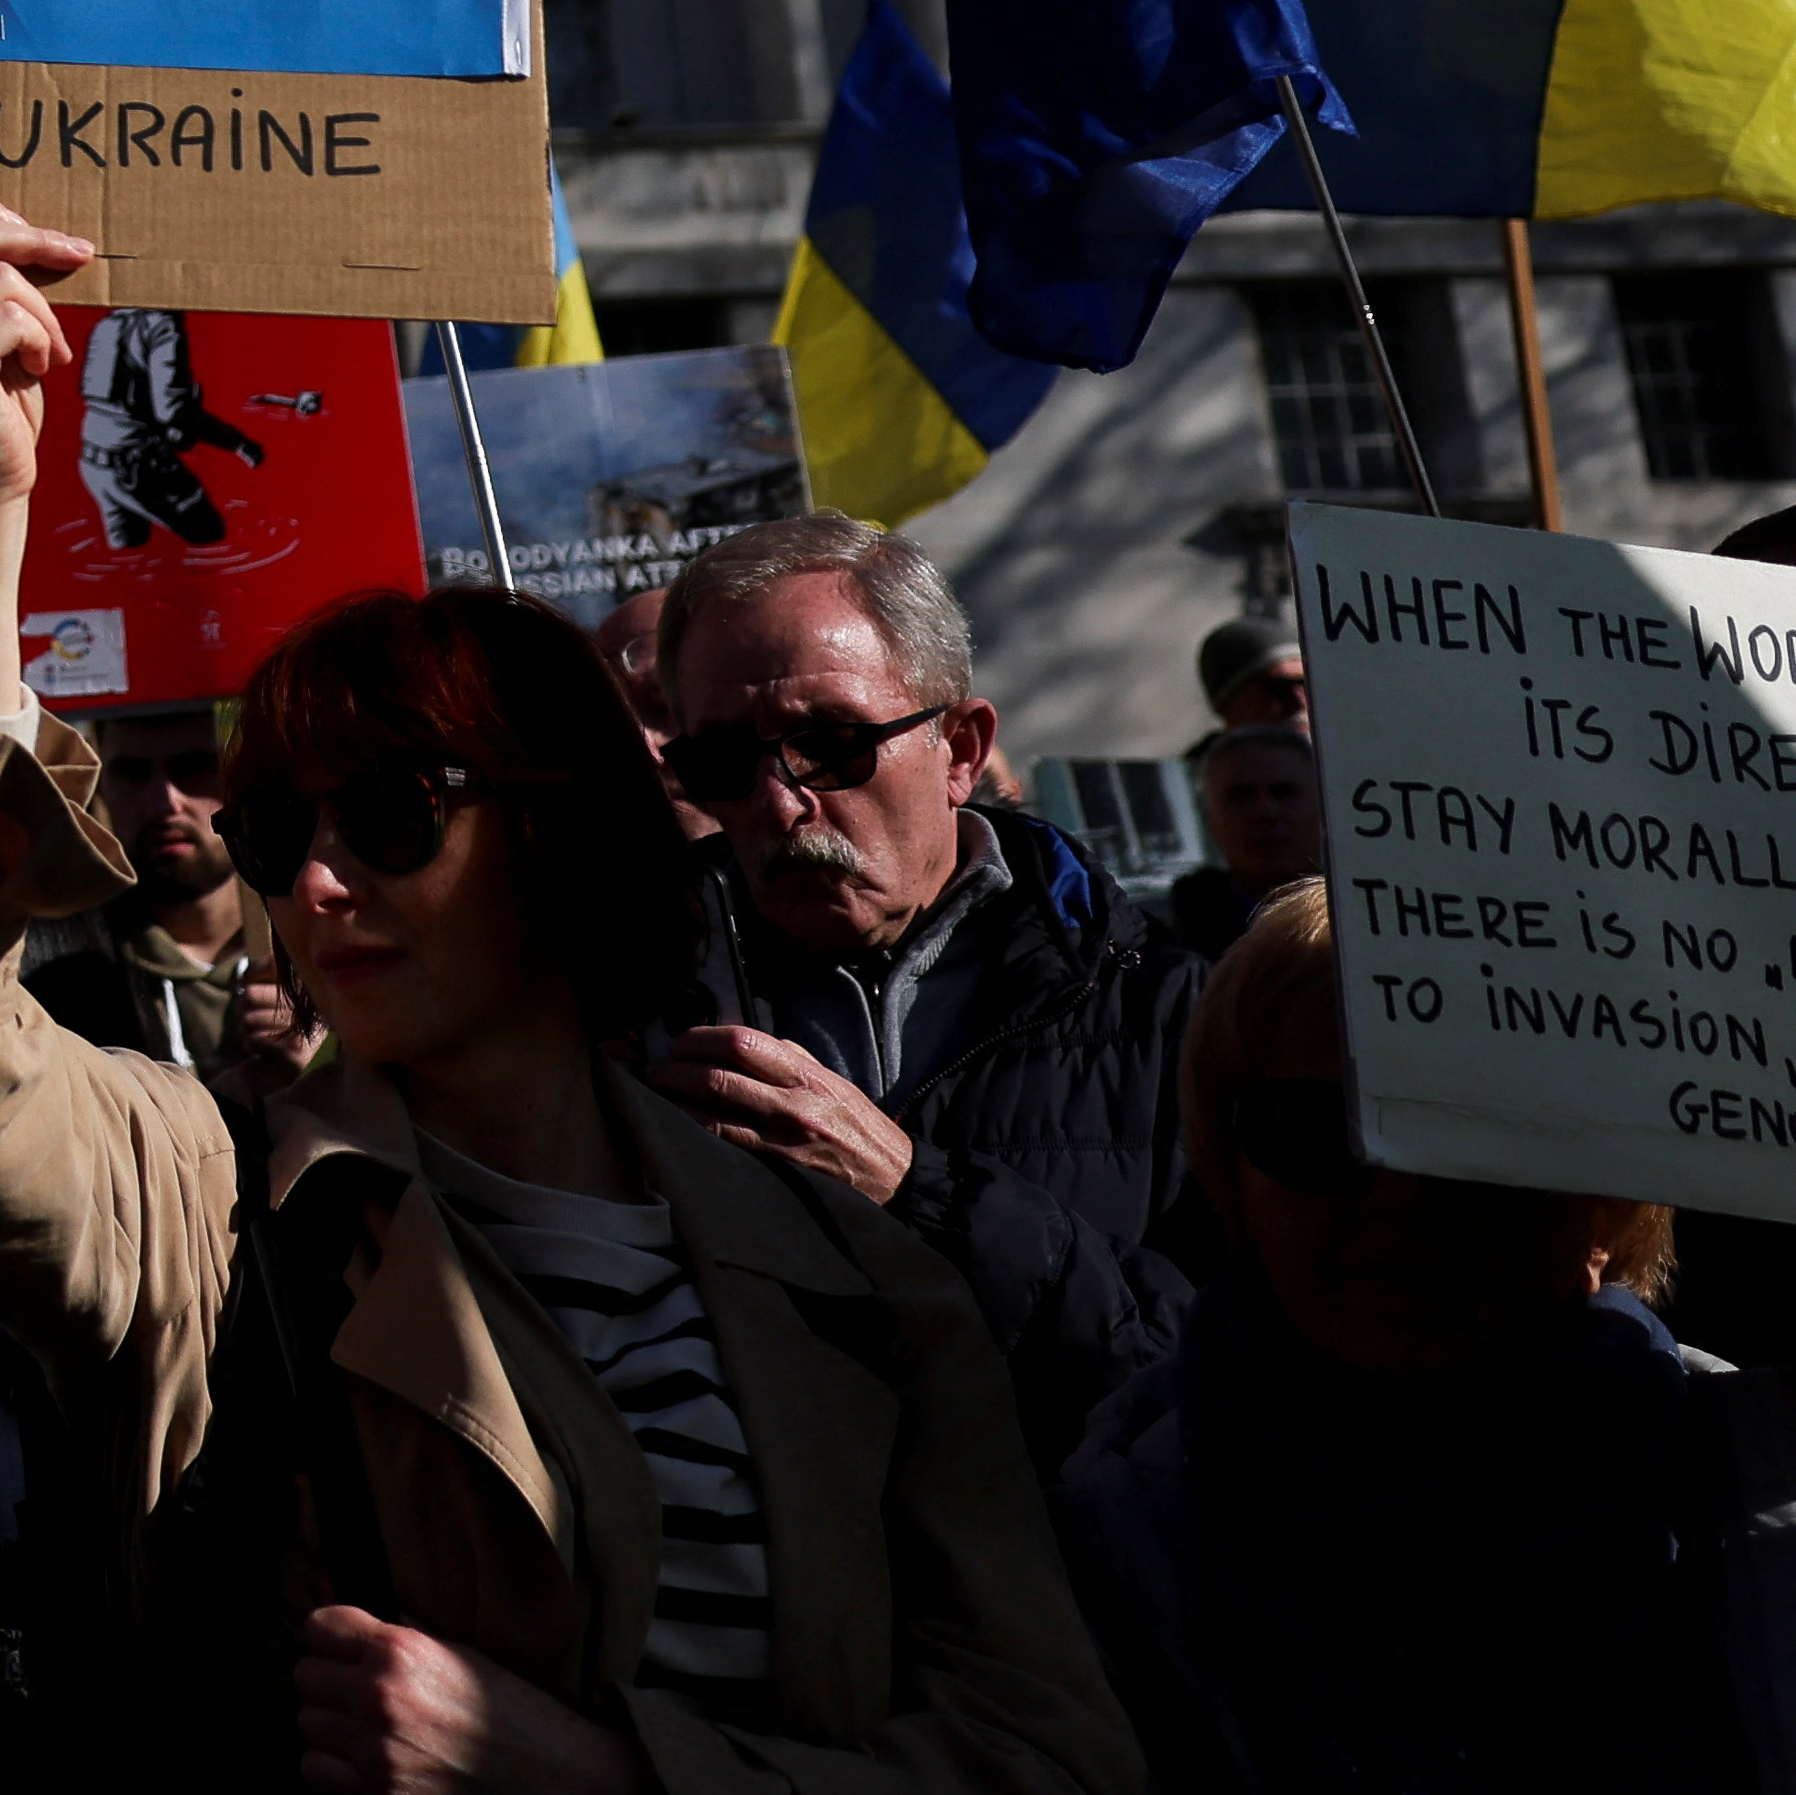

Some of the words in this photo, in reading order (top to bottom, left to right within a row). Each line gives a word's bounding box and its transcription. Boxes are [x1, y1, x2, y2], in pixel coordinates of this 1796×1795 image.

[440, 533, 659, 580] BOODYANKA
[669, 524, 747, 555] AFT
[514, 565, 617, 599] SSIAN
[624, 559, 687, 590] ATT
[1316, 564, 1527, 656] WHEN
[1559, 606, 1682, 670] THE
[1351, 778, 1516, 857] STAY
[1549, 802, 1796, 891] MORALL
[1352, 877, 1558, 950] THERE
[1663, 920, 1738, 974] NO
[1372, 972, 1444, 1024] TO
